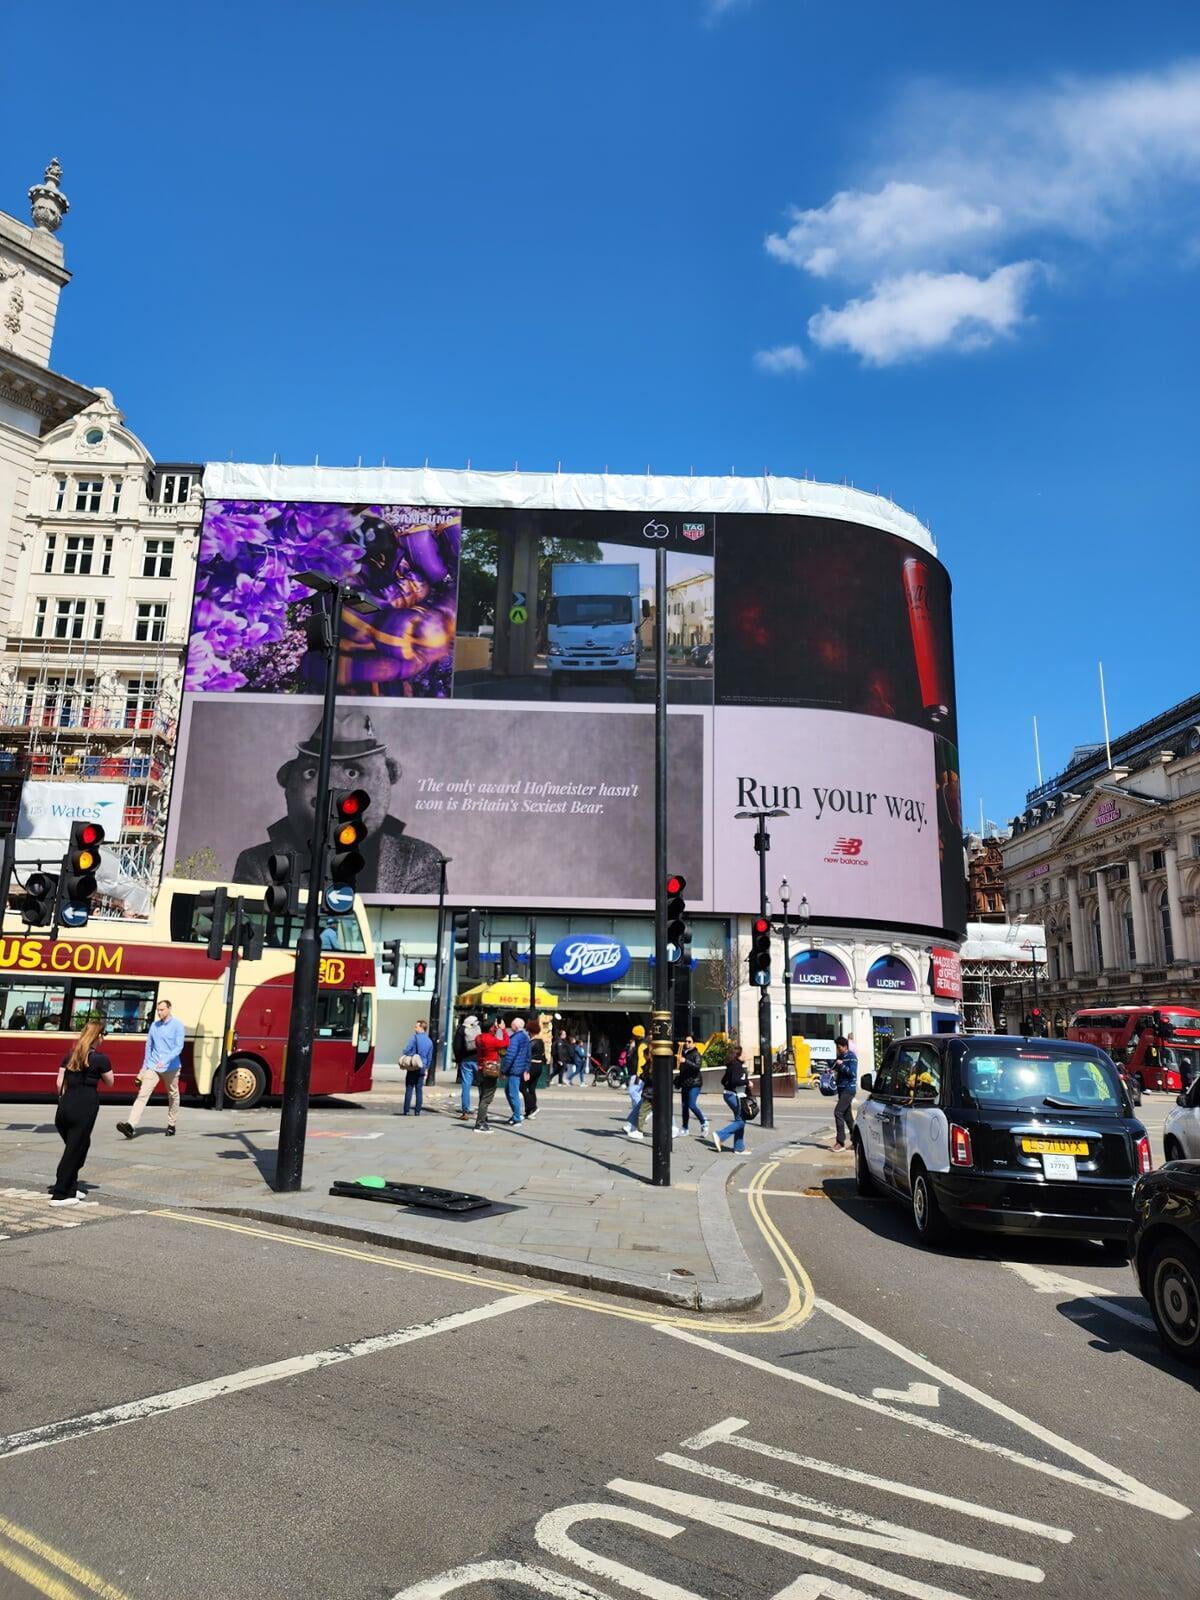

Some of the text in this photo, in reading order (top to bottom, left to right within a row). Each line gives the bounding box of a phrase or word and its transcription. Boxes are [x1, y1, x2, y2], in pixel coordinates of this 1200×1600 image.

[391, 512, 454, 525] SAMSUNG
[417, 777, 639, 797] The only award Hofmeister hasn't
[51, 804, 102, 819] Wates
[415, 797, 604, 814] won is Britain's Sexiest Bear.
[735, 776, 928, 833] Run your way.
[840, 857, 869, 866] balance
[557, 942, 622, 976] Boots
[799, 973, 829, 984] LUCENT
[876, 979, 900, 988] LUCENT
[499, 996, 542, 1005] HOT DG
